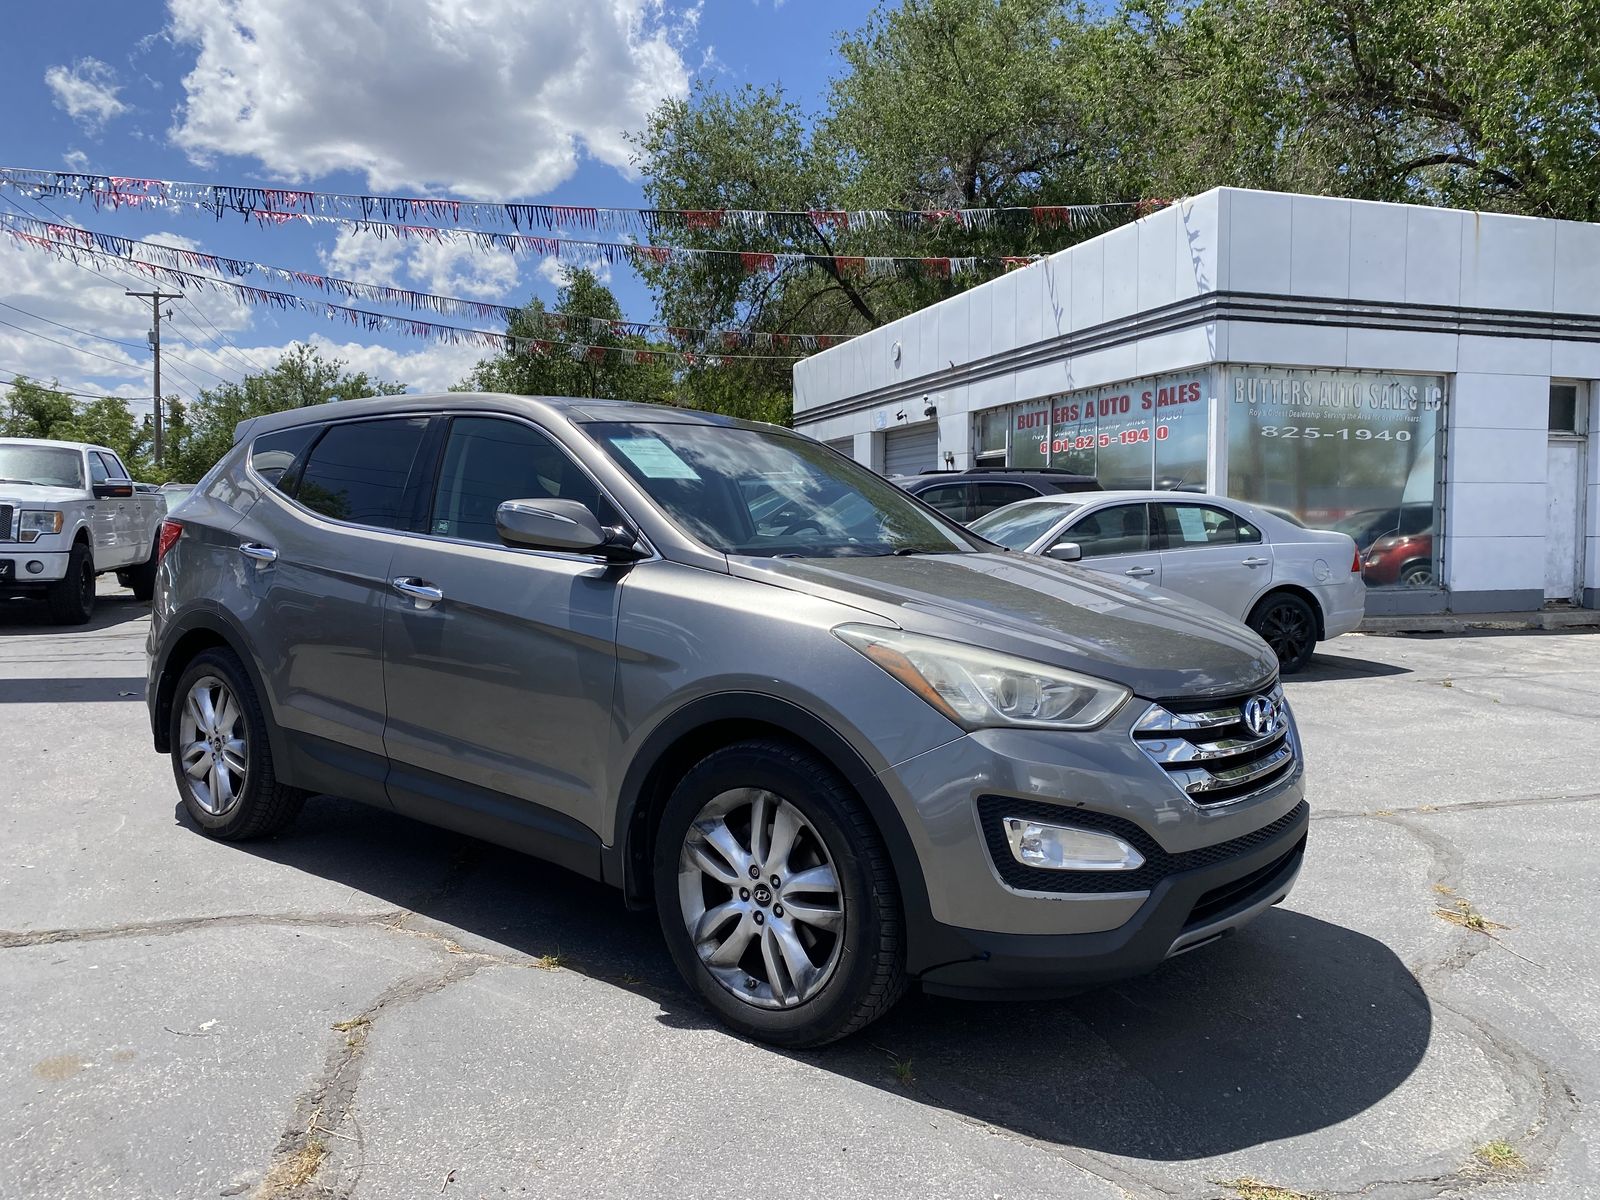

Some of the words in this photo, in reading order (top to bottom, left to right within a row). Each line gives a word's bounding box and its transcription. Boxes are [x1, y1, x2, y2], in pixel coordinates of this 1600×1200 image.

[1018, 404, 1079, 430] BUTTERS
[1085, 395, 1130, 418] AUTO
[1142, 382, 1200, 410] SALES
[1235, 378, 1312, 405] BUTTERS
[1319, 380, 1361, 409] AUTO
[1369, 382, 1417, 411] SALES
[1261, 425, 1411, 441] 825-1940
